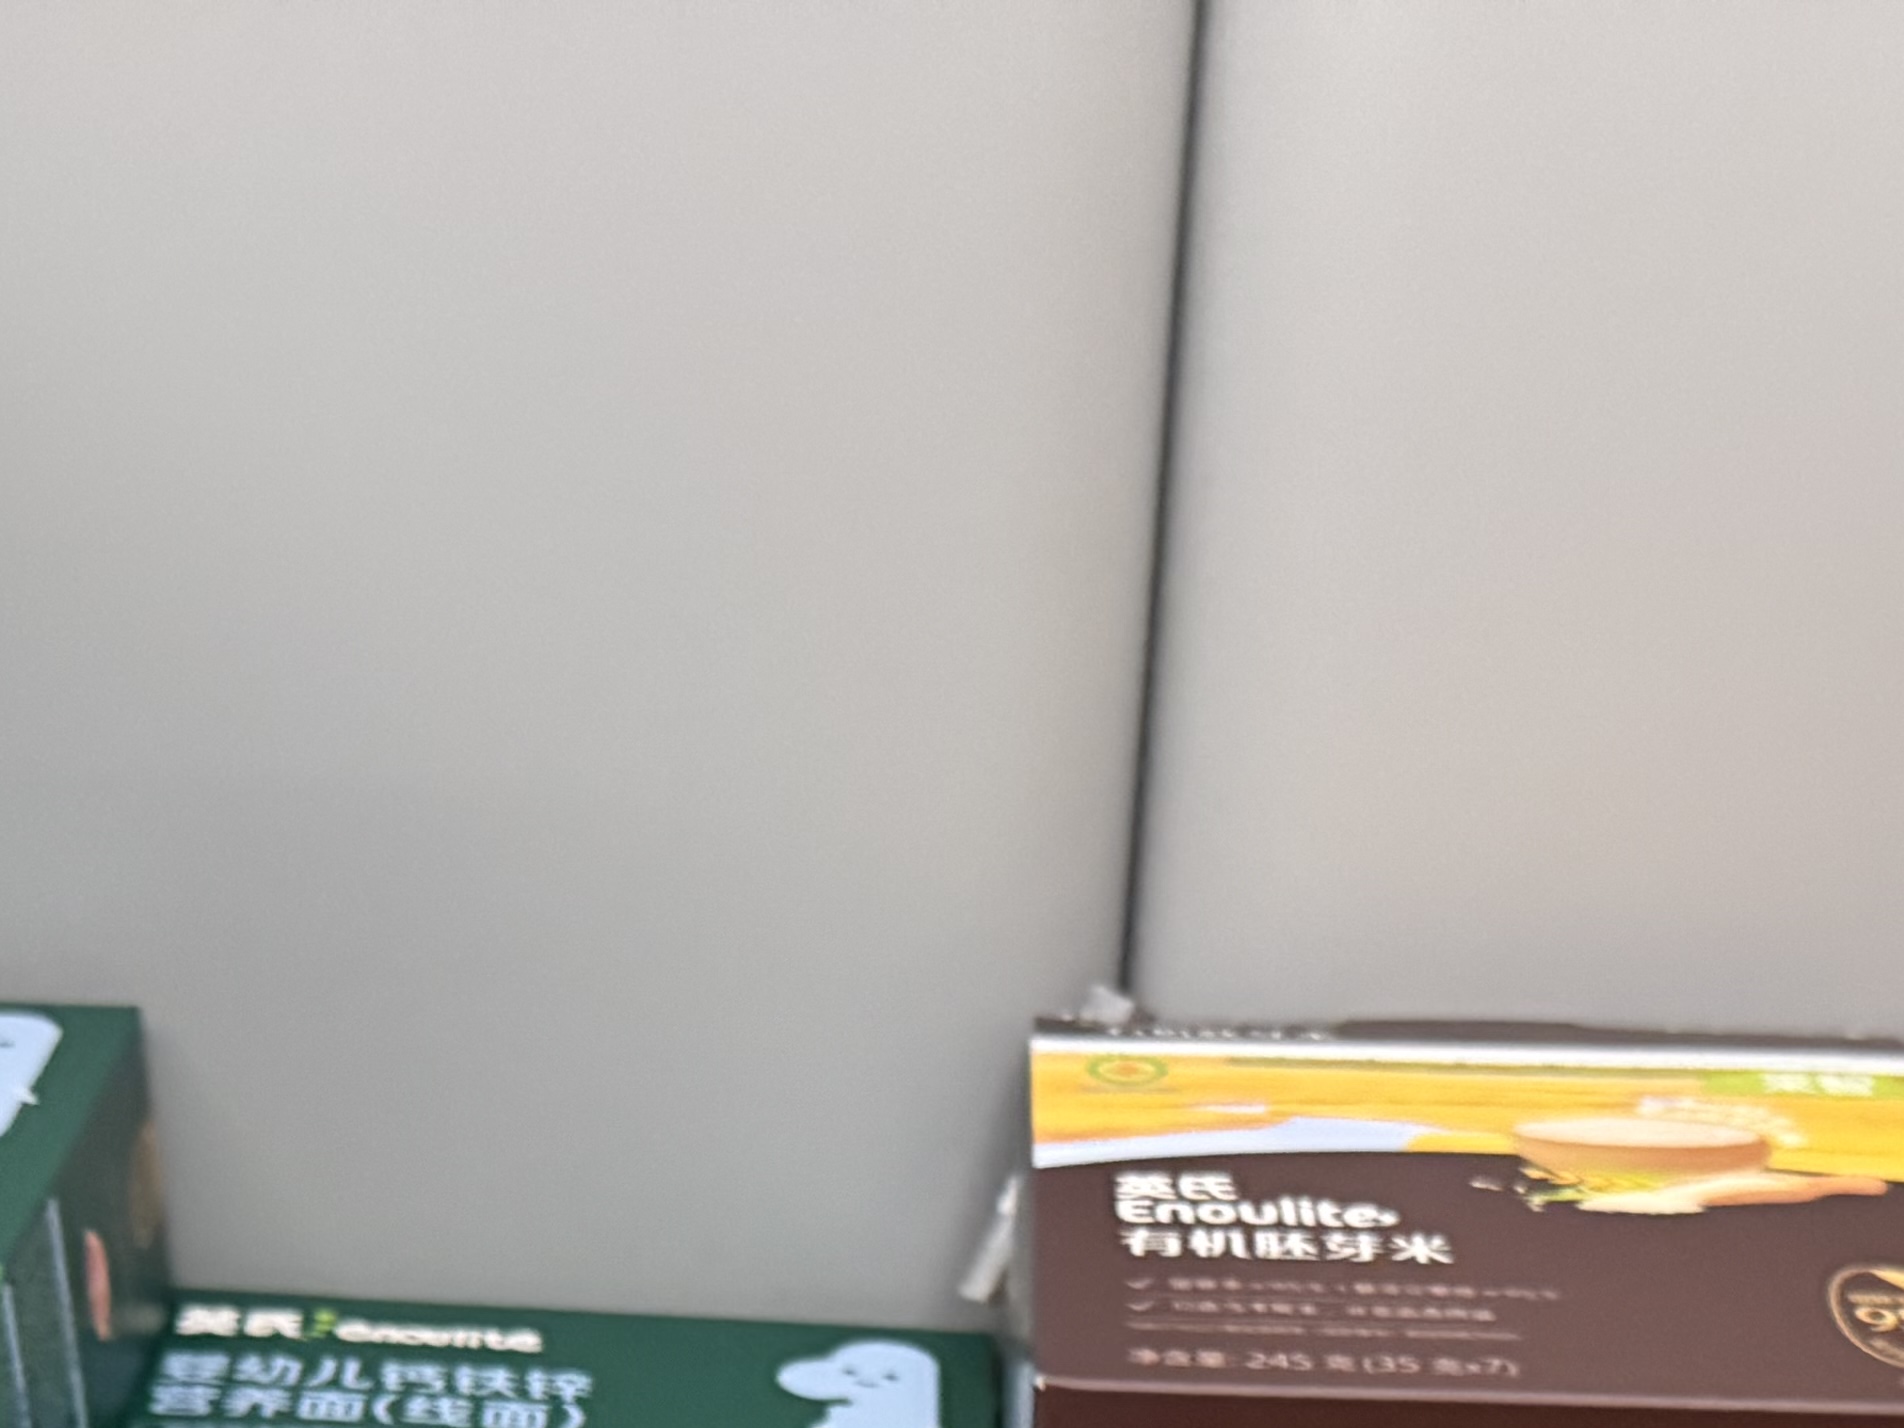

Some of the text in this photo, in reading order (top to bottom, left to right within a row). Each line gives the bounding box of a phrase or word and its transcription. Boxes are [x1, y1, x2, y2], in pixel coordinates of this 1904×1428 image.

[1115, 1172, 1236, 1202] 英氏
[1117, 1228, 1456, 1266] 有机胚芽米
